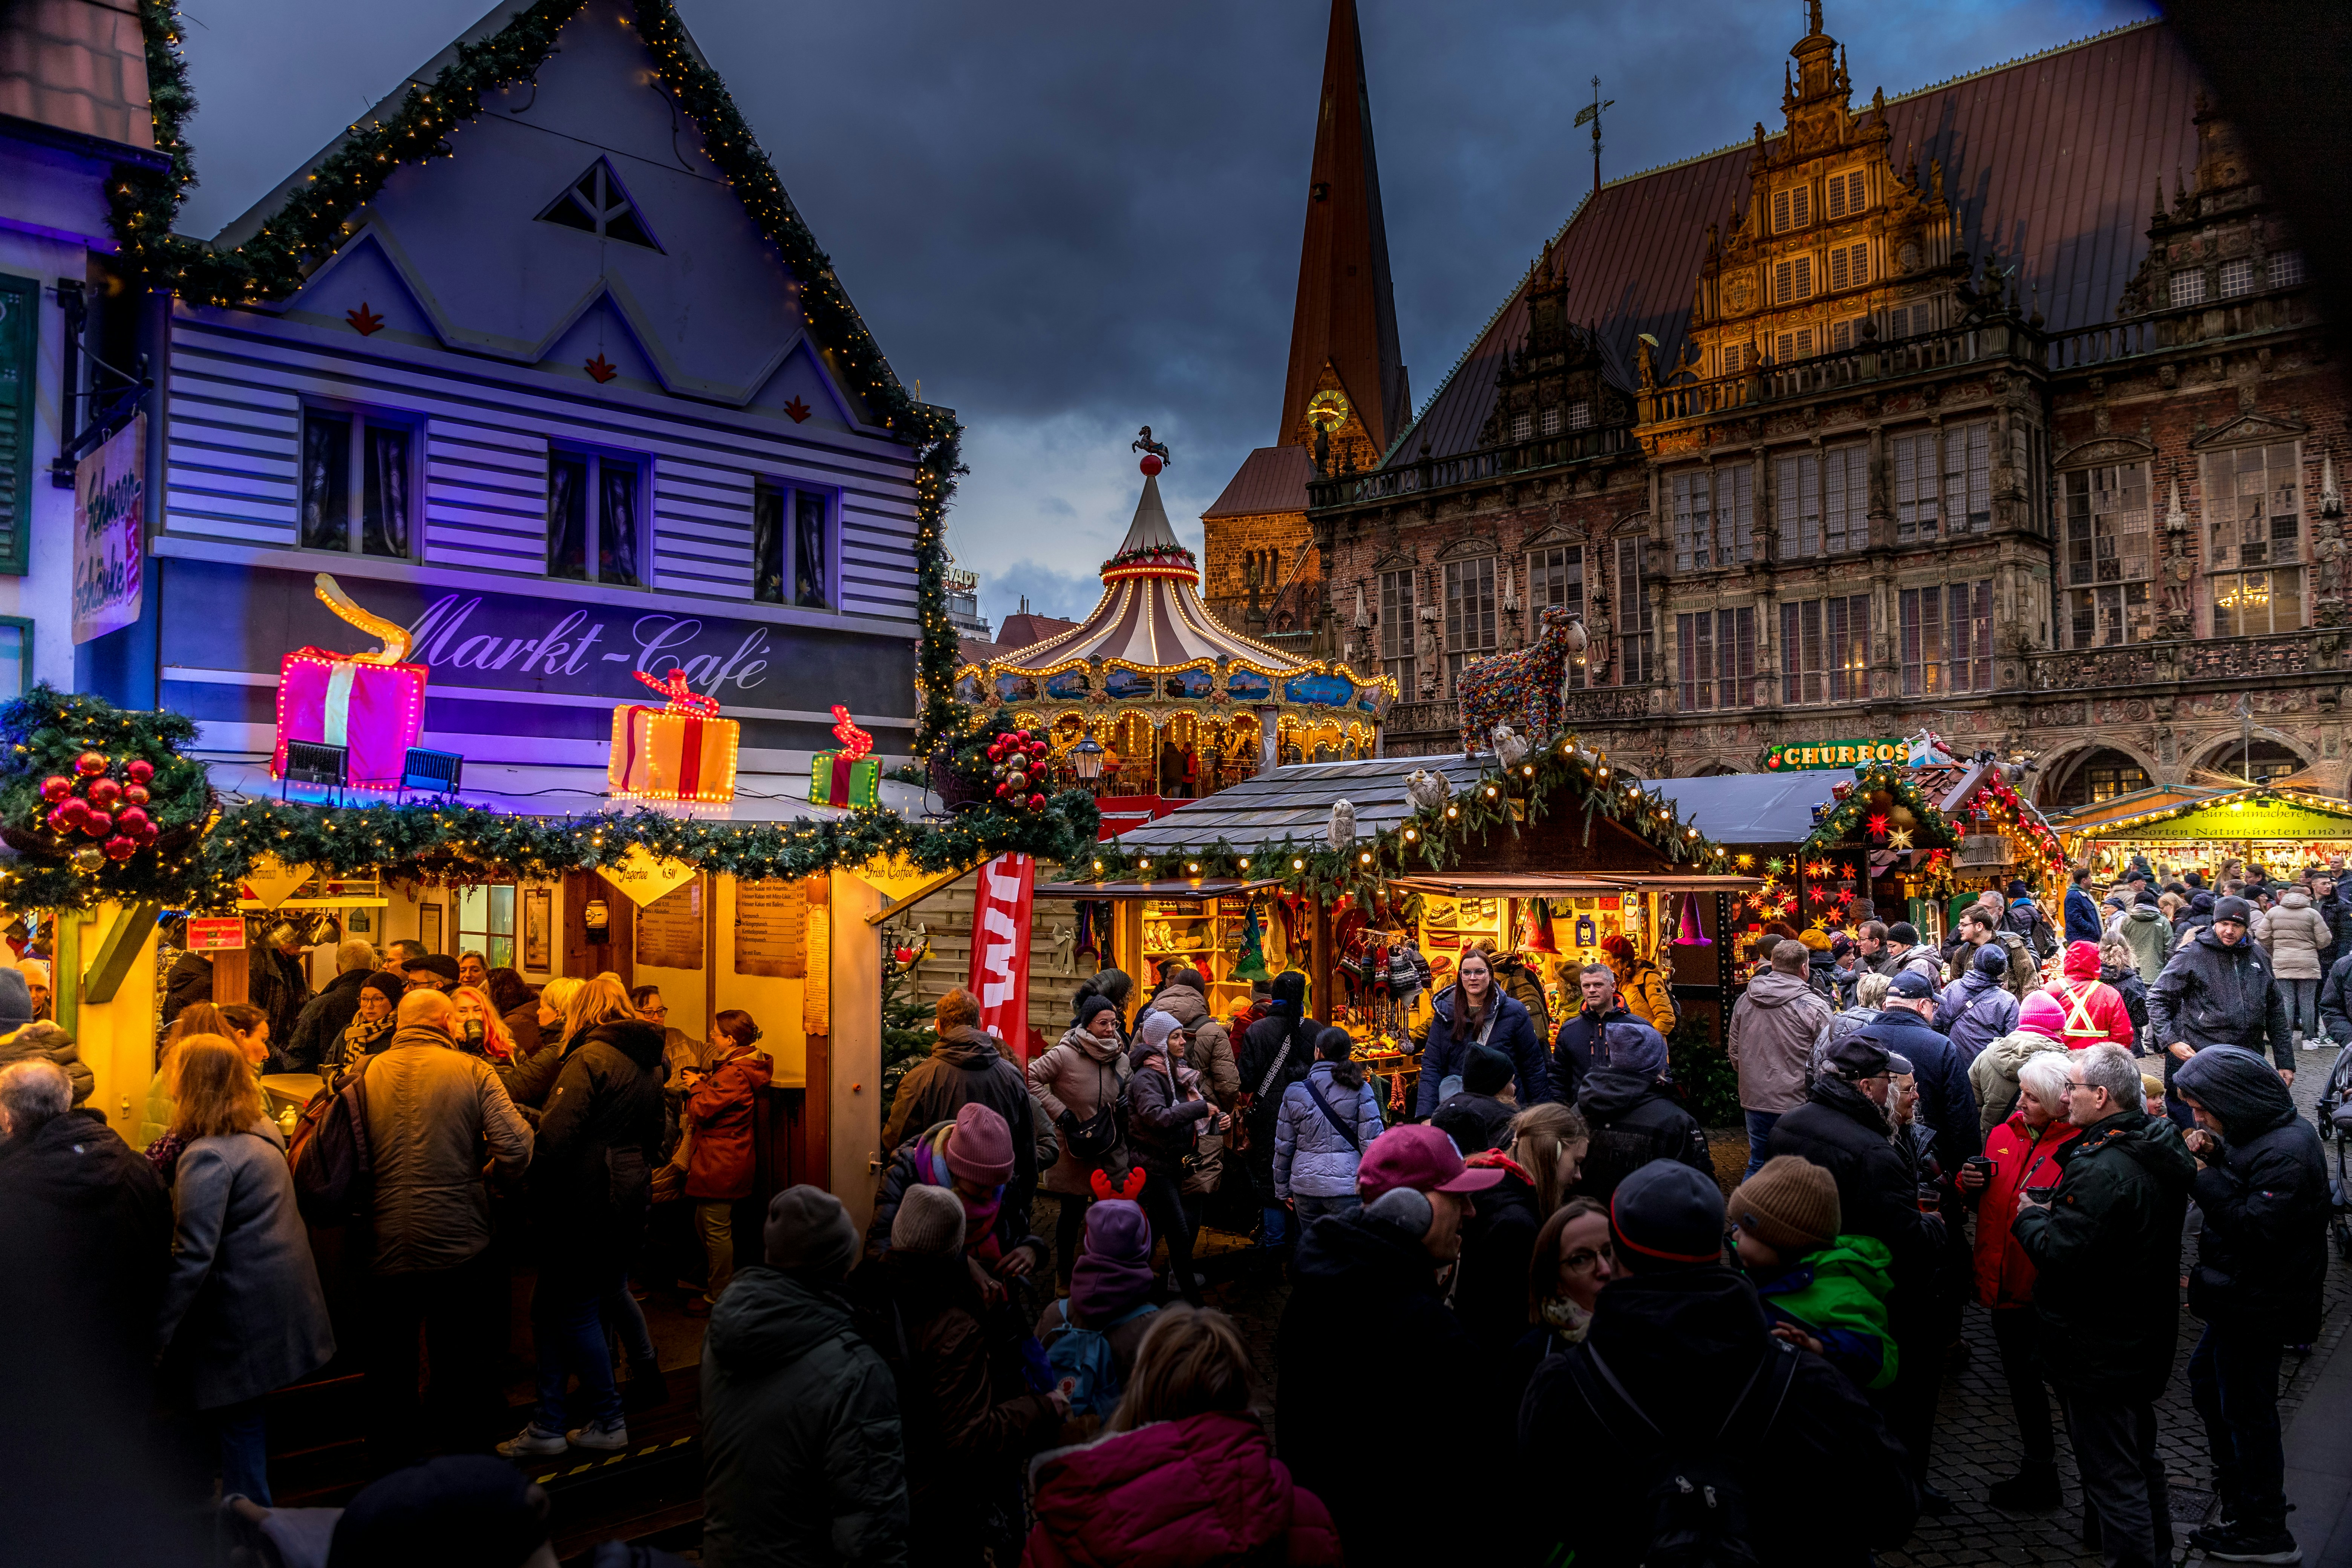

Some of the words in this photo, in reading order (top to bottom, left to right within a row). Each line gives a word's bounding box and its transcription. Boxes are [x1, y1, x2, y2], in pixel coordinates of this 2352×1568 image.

[1784, 744, 1909, 764] CHURROS
[2201, 806, 2310, 821] Bürstenmacherey
[865, 862, 885, 879] Irish
[888, 861, 913, 881] Coffee
